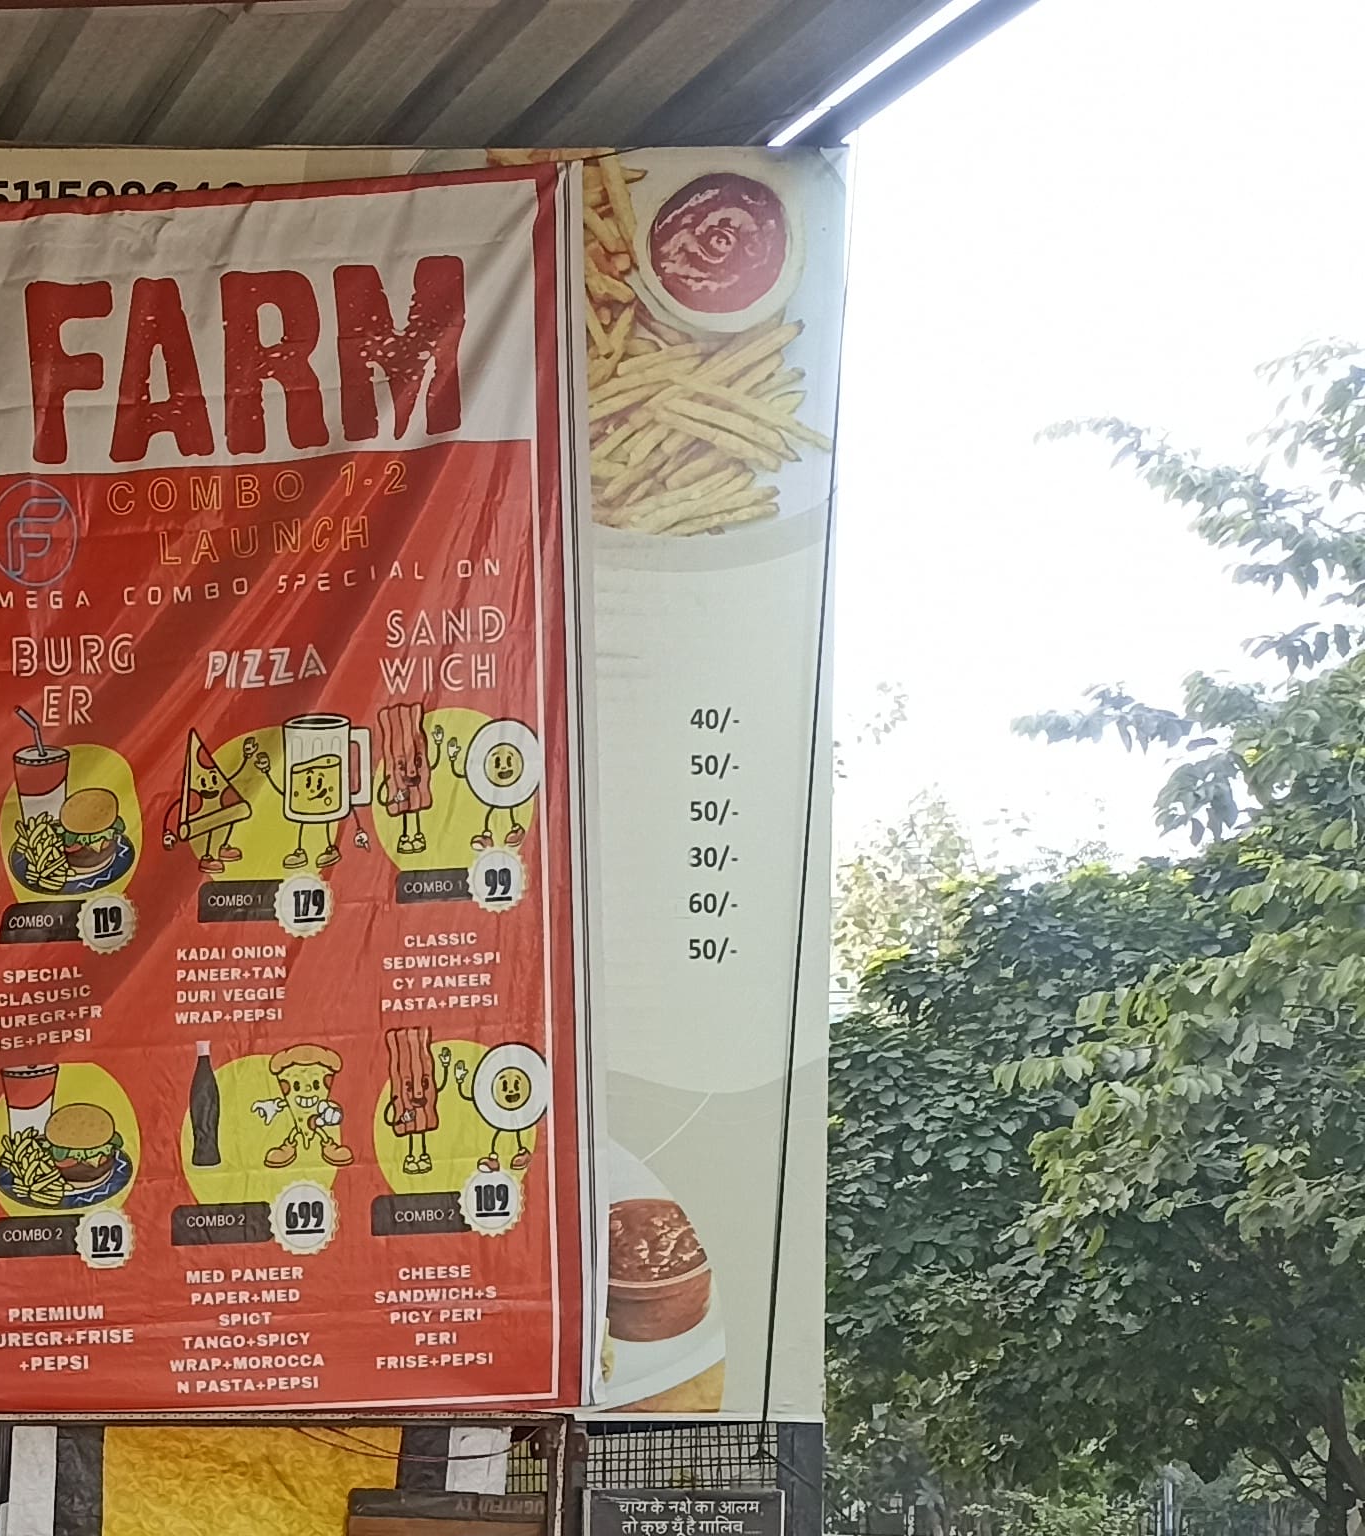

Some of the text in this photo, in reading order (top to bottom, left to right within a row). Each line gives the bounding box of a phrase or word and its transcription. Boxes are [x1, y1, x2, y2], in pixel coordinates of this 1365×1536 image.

[24, 255, 465, 464] FARM
[107, 468, 305, 515] COMBO
[159, 516, 369, 566] LAUNCH
[124, 577, 248, 606] COMBO
[277, 562, 424, 594] SPECIAL
[457, 559, 501, 578] ON
[386, 606, 506, 648] SAND
[12, 634, 135, 676] BURG
[205, 644, 327, 690] PIZZA
[379, 653, 496, 696] WICH
[43, 685, 93, 726] ER
[690, 707, 740, 734] 40/-
[691, 753, 739, 780] 50/-
[690, 799, 739, 826] 50/-
[689, 844, 738, 872] 30/-
[688, 891, 738, 918] 60/-
[176, 945, 287, 961] KADAI ONION
[689, 937, 737, 964] 50/-
[8, 1305, 104, 1323] PREMIUM
